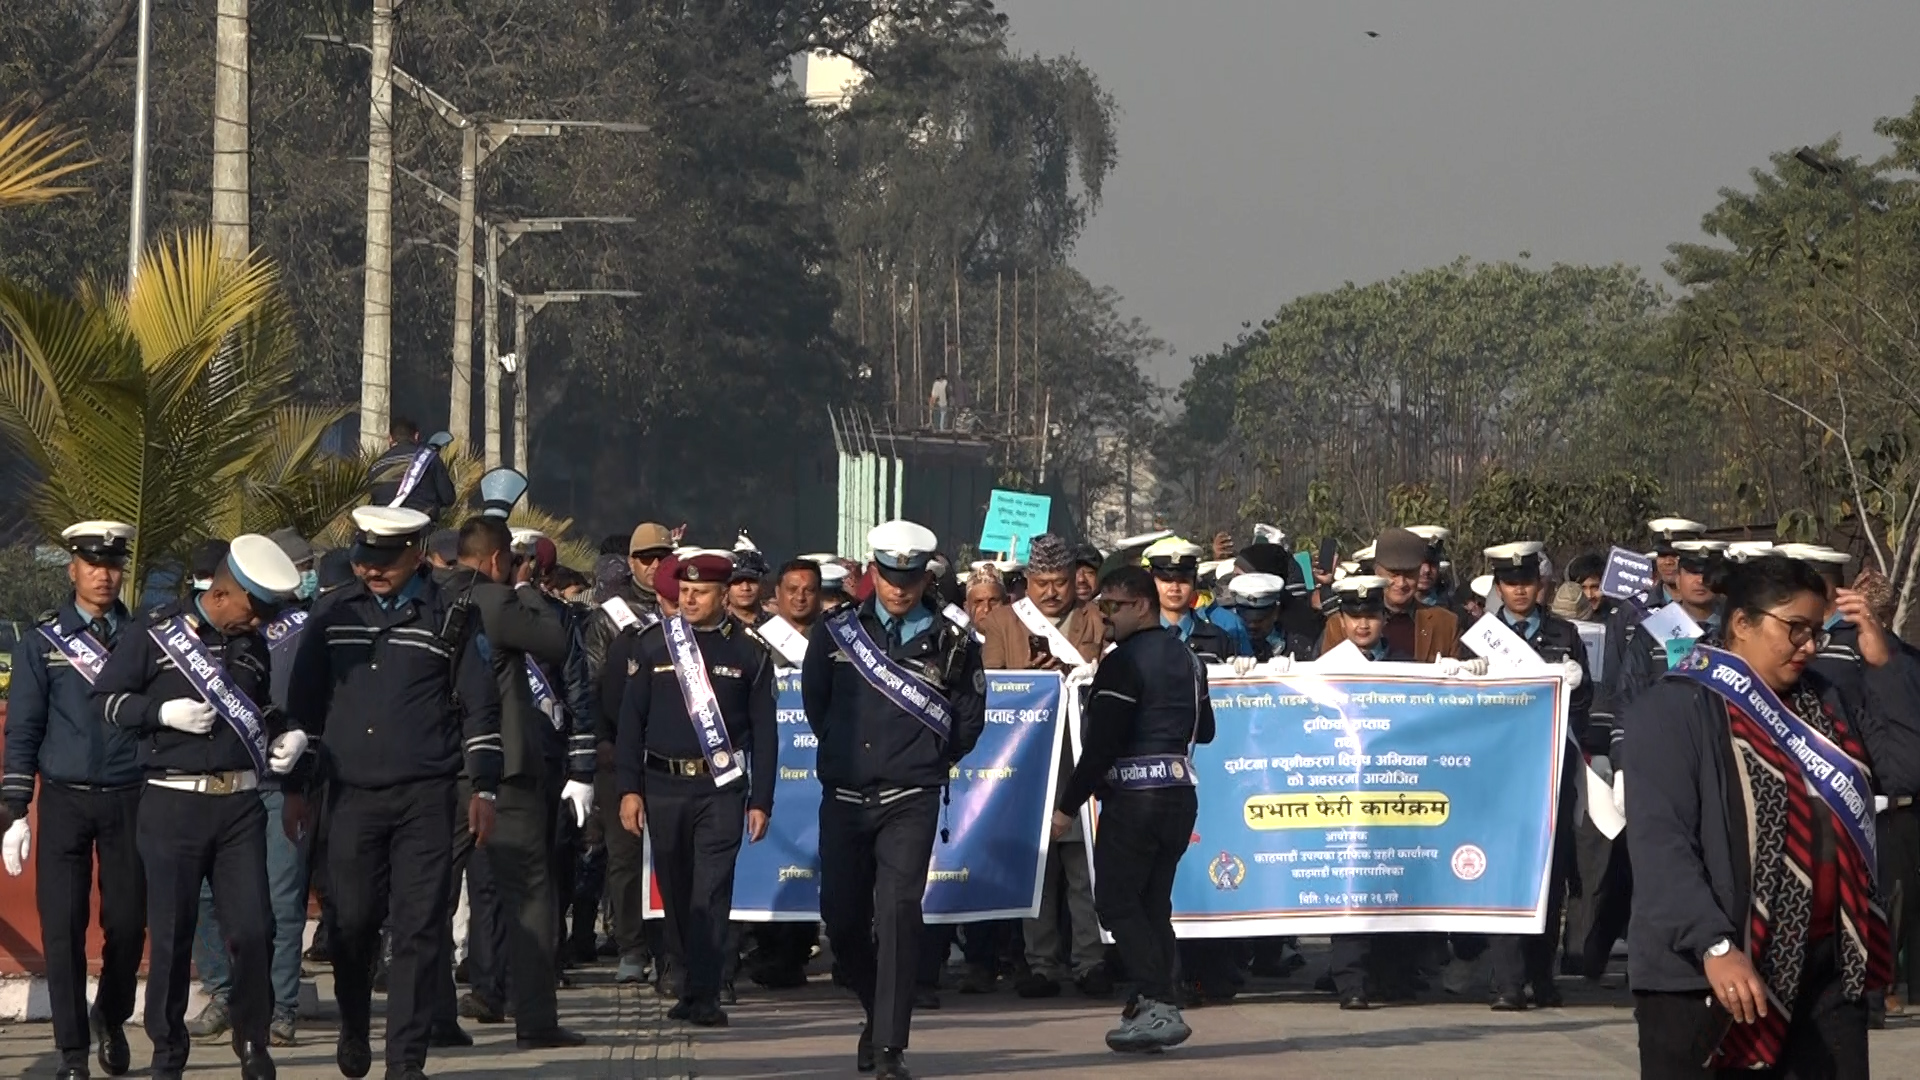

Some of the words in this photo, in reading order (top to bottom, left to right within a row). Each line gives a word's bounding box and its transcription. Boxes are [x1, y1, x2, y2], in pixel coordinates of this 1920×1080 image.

[1711, 663, 1752, 694] सवारी
[1376, 751, 1428, 766] अभियान
[1286, 771, 1304, 786] को
[1363, 769, 1419, 786] आयोजित
[1247, 802, 1310, 820] प्रभात
[1315, 794, 1353, 818] फेरी
[1359, 793, 1450, 816] कार्यक्रम
